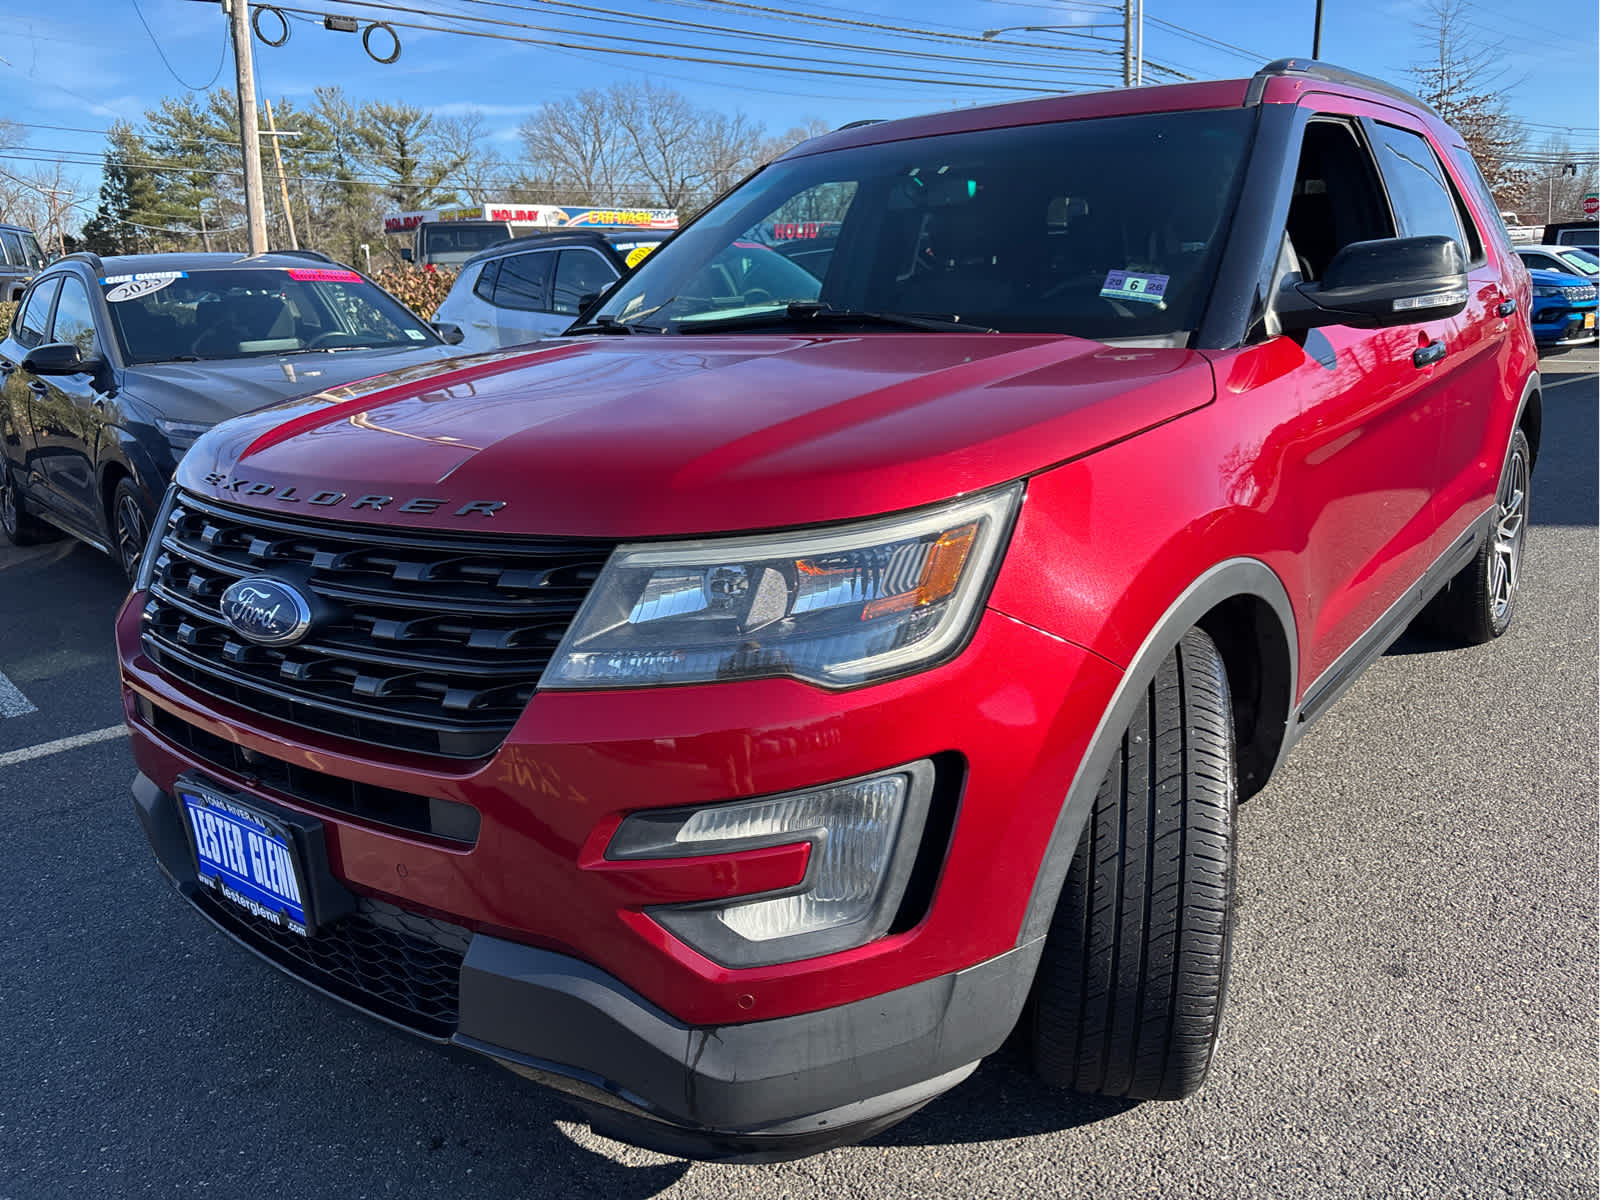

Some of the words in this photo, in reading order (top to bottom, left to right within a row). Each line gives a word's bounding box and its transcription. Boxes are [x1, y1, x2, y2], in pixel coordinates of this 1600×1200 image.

[384, 215, 424, 230] HOLIDAY
[492, 210, 539, 221] HOLIDAY
[588, 211, 615, 223] CAR
[616, 211, 652, 223] WASH
[1130, 280, 1139, 290] 6
[203, 472, 508, 517] EXPLORER
[231, 587, 281, 630] Ford
[189, 807, 248, 877] LESTER
[248, 831, 302, 904] GLENN
[221, 883, 281, 926] lesterglenn
